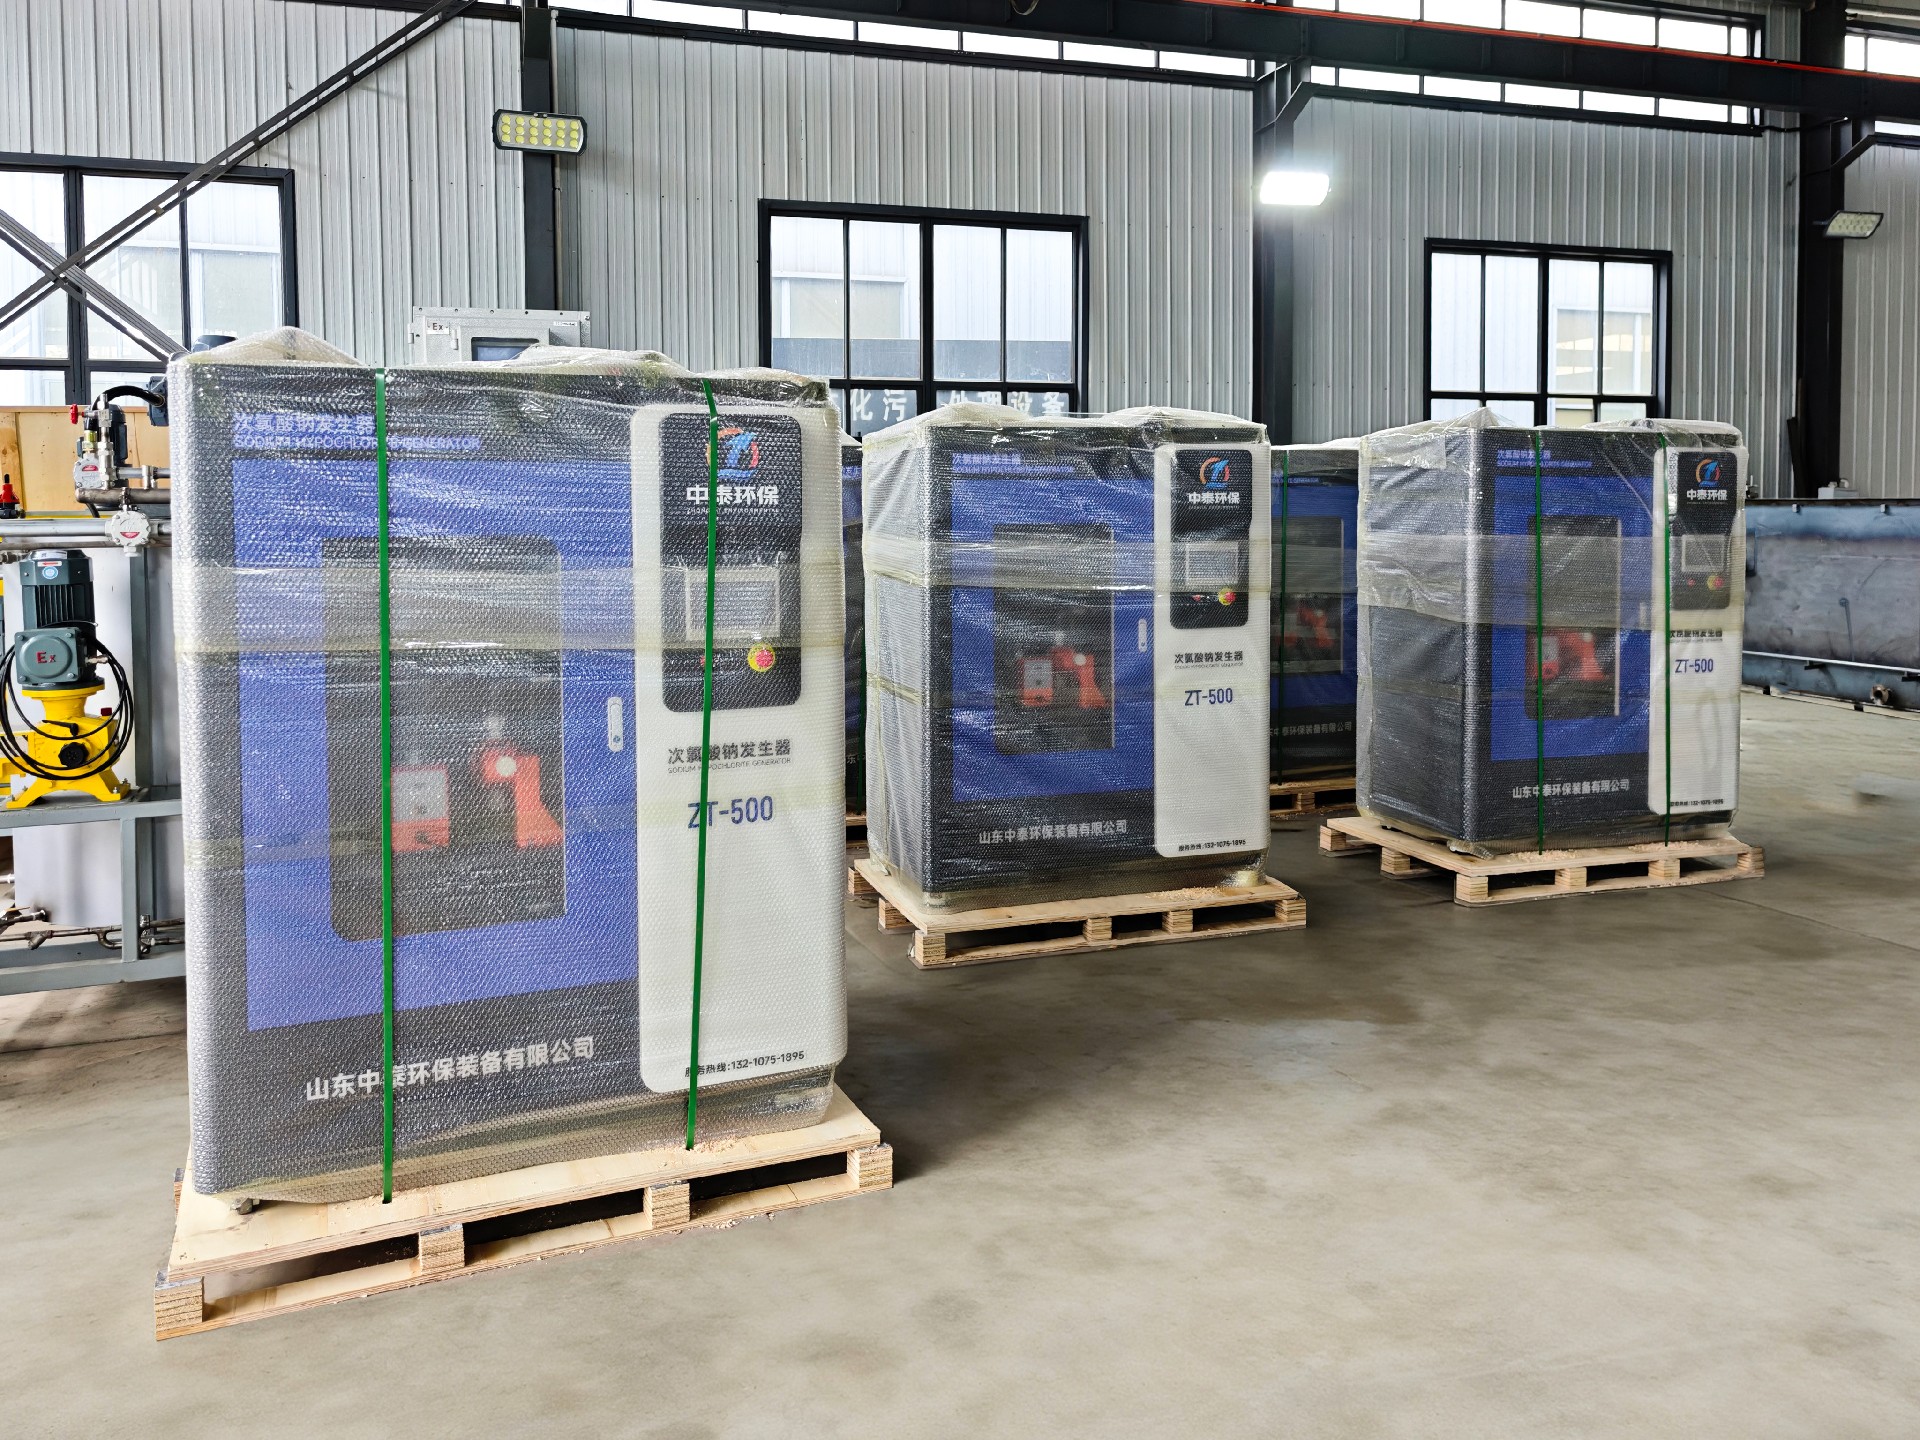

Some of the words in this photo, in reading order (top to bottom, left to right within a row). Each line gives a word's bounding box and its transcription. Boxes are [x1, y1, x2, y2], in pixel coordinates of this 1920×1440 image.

[432, 323, 444, 331] Ex
[686, 484, 779, 506] 中泰环保
[1188, 491, 1240, 505] 中泰环保
[1687, 489, 1728, 501] 中泰环保
[36, 651, 56, 664] Ex
[1675, 658, 1714, 673] ZT-500
[1184, 688, 1233, 706] ZT-500
[698, 760, 750, 771] HPOCHLORITE
[687, 795, 773, 829] ZT-500
[979, 819, 1127, 845] 山东中泰环保装备有限公司
[306, 1036, 595, 1102] 山东中泰环保装备有限公司
